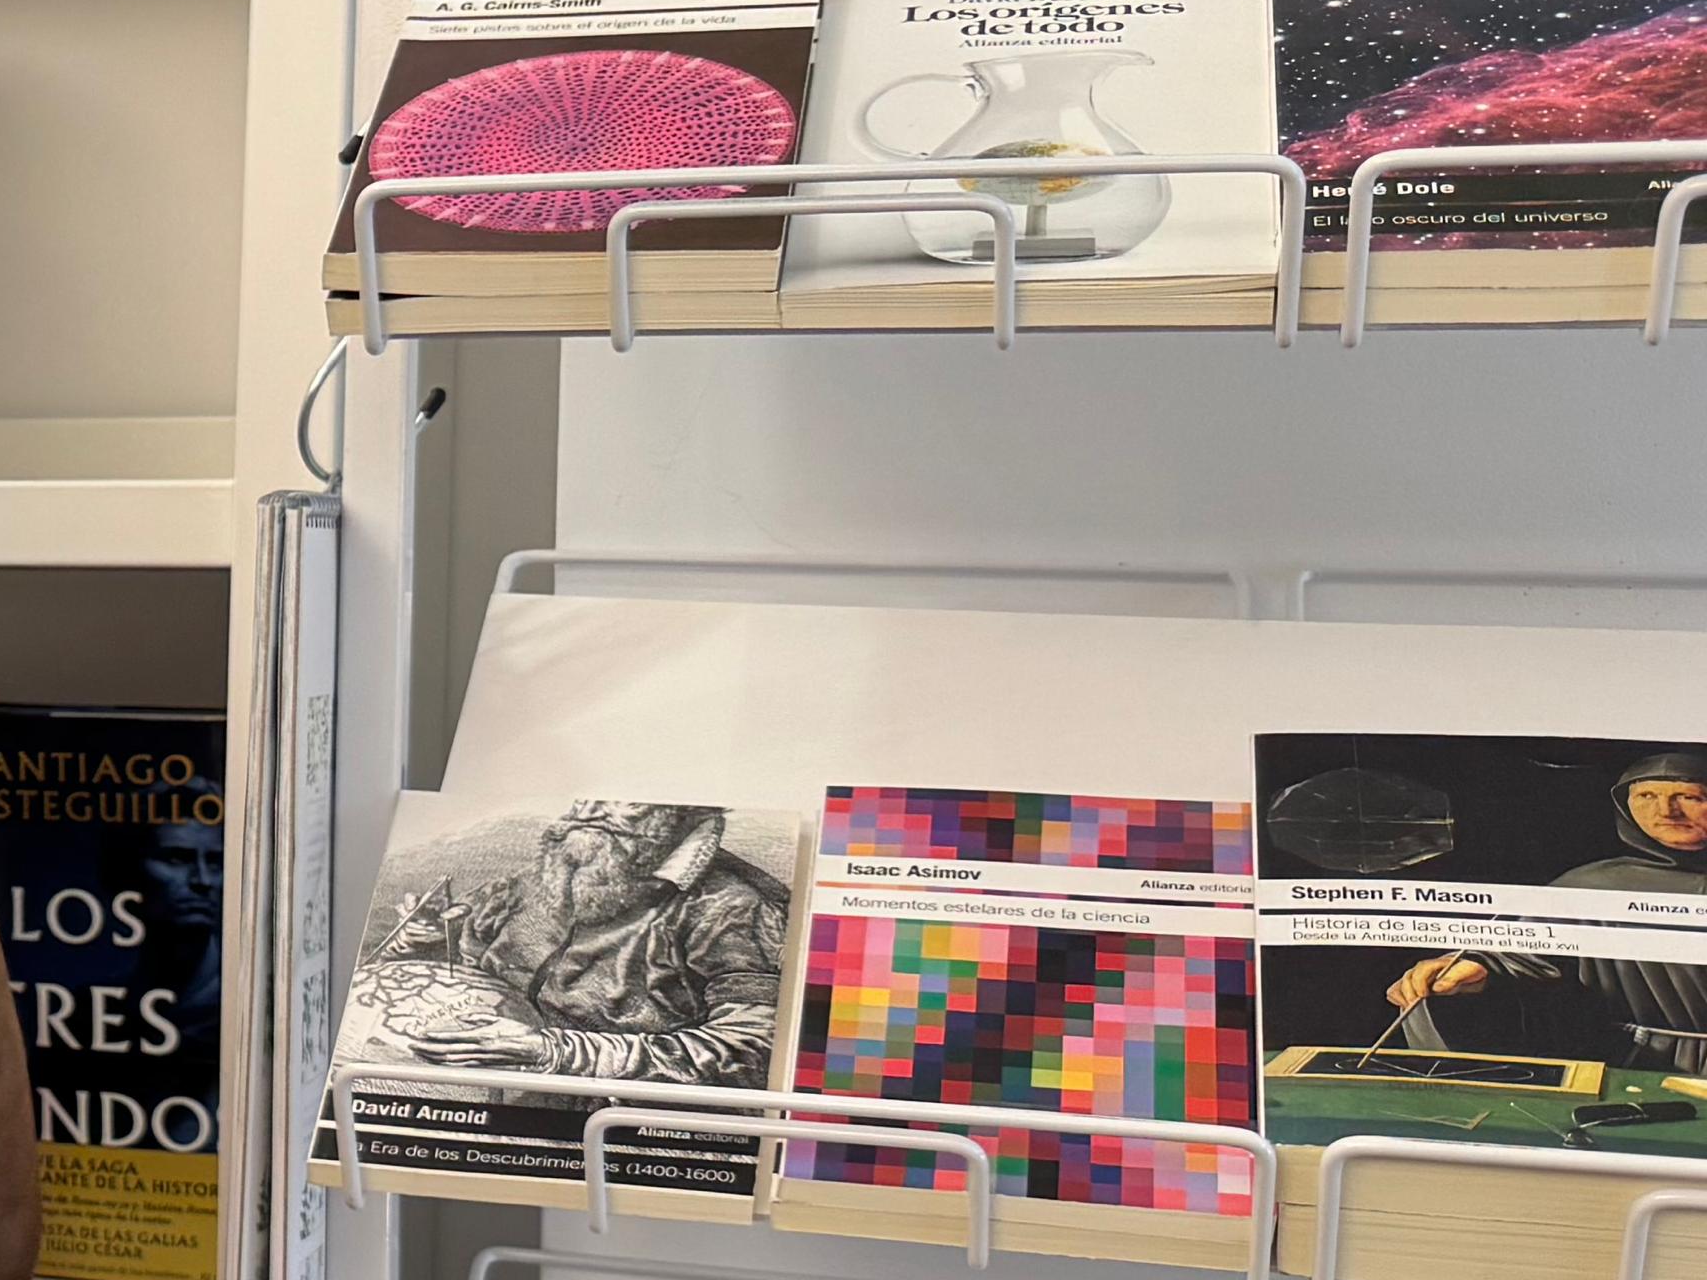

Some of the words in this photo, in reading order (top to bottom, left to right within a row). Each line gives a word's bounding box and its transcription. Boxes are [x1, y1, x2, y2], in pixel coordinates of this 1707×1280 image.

[437, 2, 452, 12] A.
[460, 1, 478, 11] G.
[901, 5, 979, 23] Los
[988, 1, 1185, 22] orígenes
[429, 24, 468, 35] Siete
[473, 23, 521, 34] pistas
[526, 22, 572, 32] sobre
[577, 20, 592, 29] el
[597, 18, 650, 31] origen
[653, 17, 675, 27] de
[681, 17, 696, 25] la
[701, 15, 735, 25] vida
[960, 19, 1015, 36] de
[1023, 17, 1125, 36] todo
[959, 39, 1032, 48] Alianza
[1038, 36, 1122, 46] editorial
[1313, 183, 1387, 198] Heré
[1397, 181, 1455, 196] Dole
[1313, 215, 1331, 227] El
[1392, 212, 1465, 225] oscuro
[1473, 212, 1505, 224] del
[1514, 209, 1608, 223] universo
[847, 861, 901, 877] Isaac
[907, 865, 982, 882] Asimov
[1140, 878, 1195, 892] Alianza
[1200, 881, 1253, 894] editoria
[1291, 885, 1383, 903] Stephen
[1391, 887, 1407, 901] F.
[1415, 888, 1493, 905] Mason
[10, 885, 146, 947] LOS
[842, 896, 938, 911] Momentos
[944, 901, 1026, 917] estelares
[1031, 906, 1055, 918] de
[1061, 906, 1077, 921] la
[1082, 910, 1150, 925] ciencia
[1627, 902, 1689, 914] Alianza
[1293, 917, 1371, 931] Historia
[1379, 920, 1405, 931] de
[1412, 921, 1442, 933] las
[1448, 921, 1536, 938] ciencias
[1545, 926, 1556, 938] 1
[1293, 931, 1339, 941] Desde
[1343, 932, 1357, 941] la
[1361, 932, 1447, 944] Antigüedad
[1453, 935, 1493, 946] hasta
[1499, 937, 1511, 947] el
[1516, 939, 1551, 950] siglo
[351, 1099, 410, 1119] David
[416, 1105, 488, 1126] Arnold
[637, 1125, 690, 1139] Alianza
[694, 1130, 749, 1145] editorial
[370, 1141, 399, 1156] Era
[405, 1144, 429, 1158] de
[435, 1146, 460, 1162] los
[625, 1162, 736, 1184] (1400-1600)
